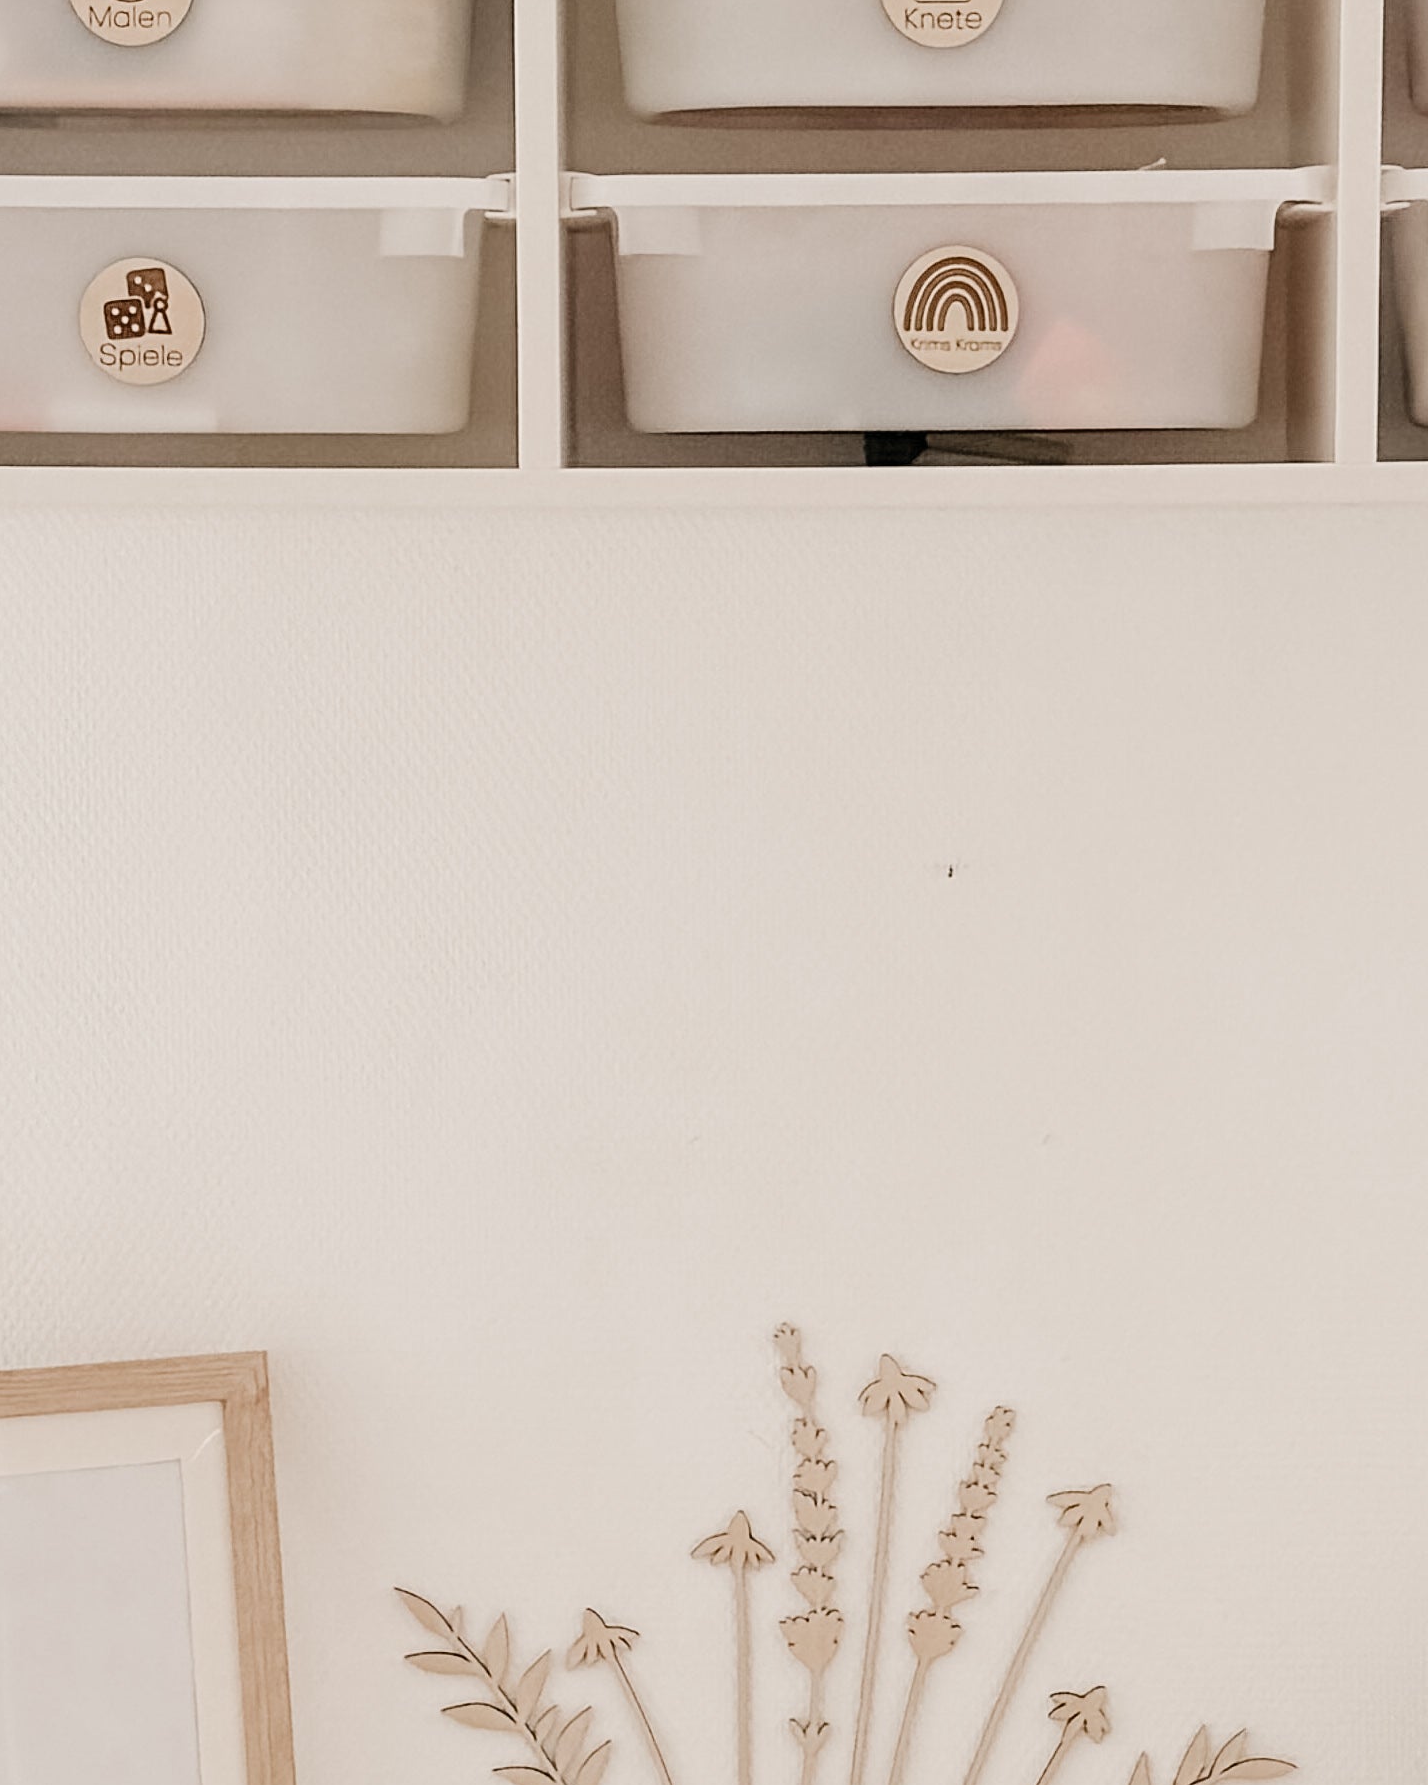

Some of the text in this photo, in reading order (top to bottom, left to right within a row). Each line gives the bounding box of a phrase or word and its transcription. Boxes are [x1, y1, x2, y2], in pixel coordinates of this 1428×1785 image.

[88, 5, 172, 29] Malen
[904, 7, 983, 30] Knete
[99, 343, 183, 372] Spiele
